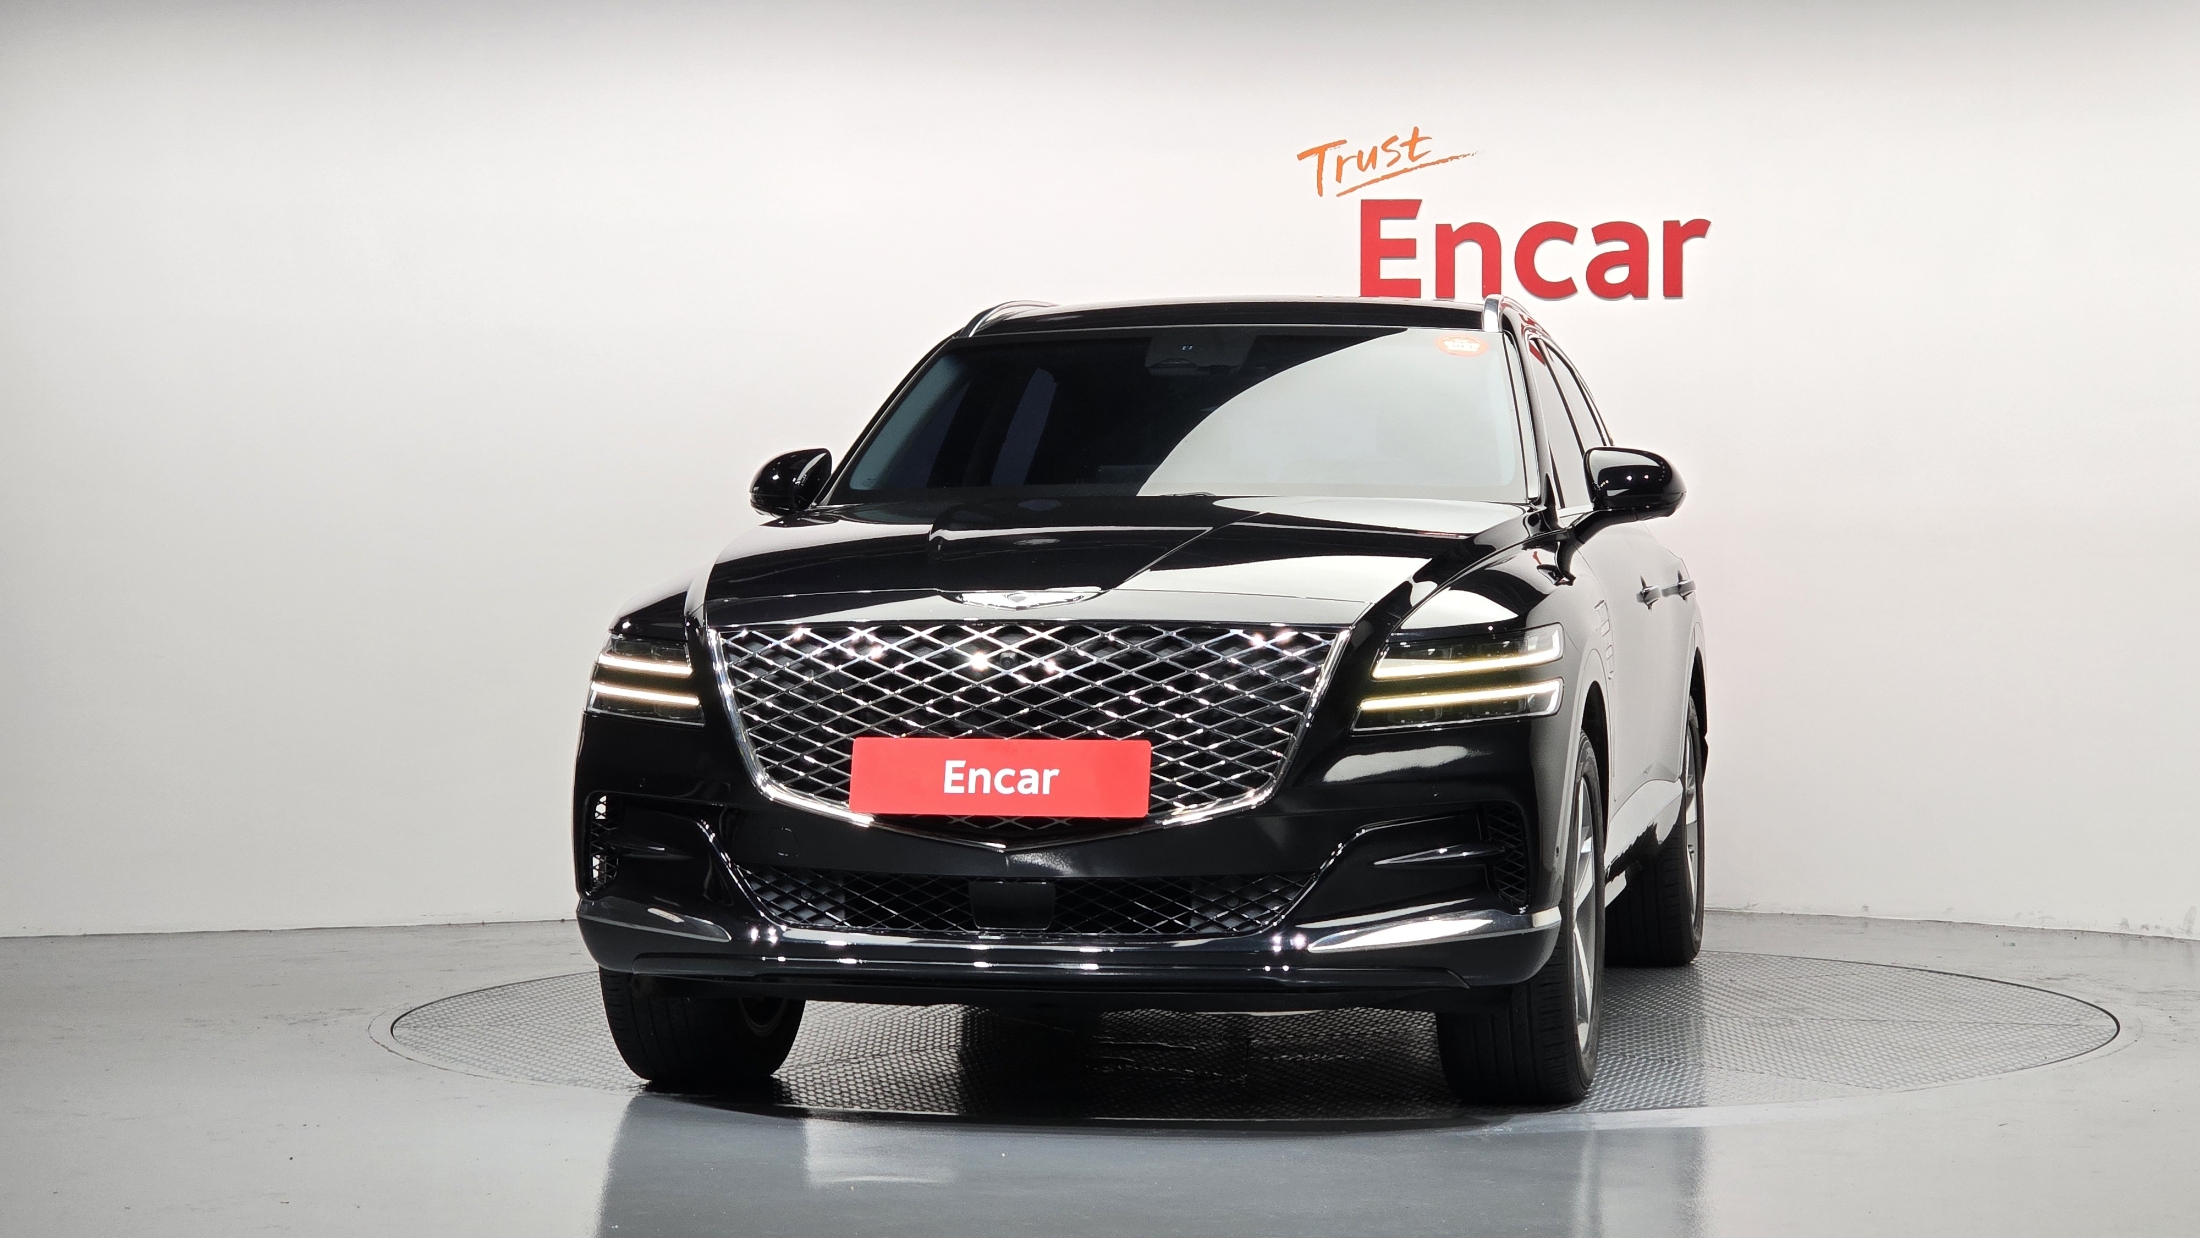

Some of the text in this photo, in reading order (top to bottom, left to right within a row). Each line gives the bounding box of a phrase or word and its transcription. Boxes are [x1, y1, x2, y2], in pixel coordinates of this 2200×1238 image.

[1297, 126, 1432, 197] Trust
[1360, 199, 1711, 300] Encar
[943, 760, 1060, 795] Encar
